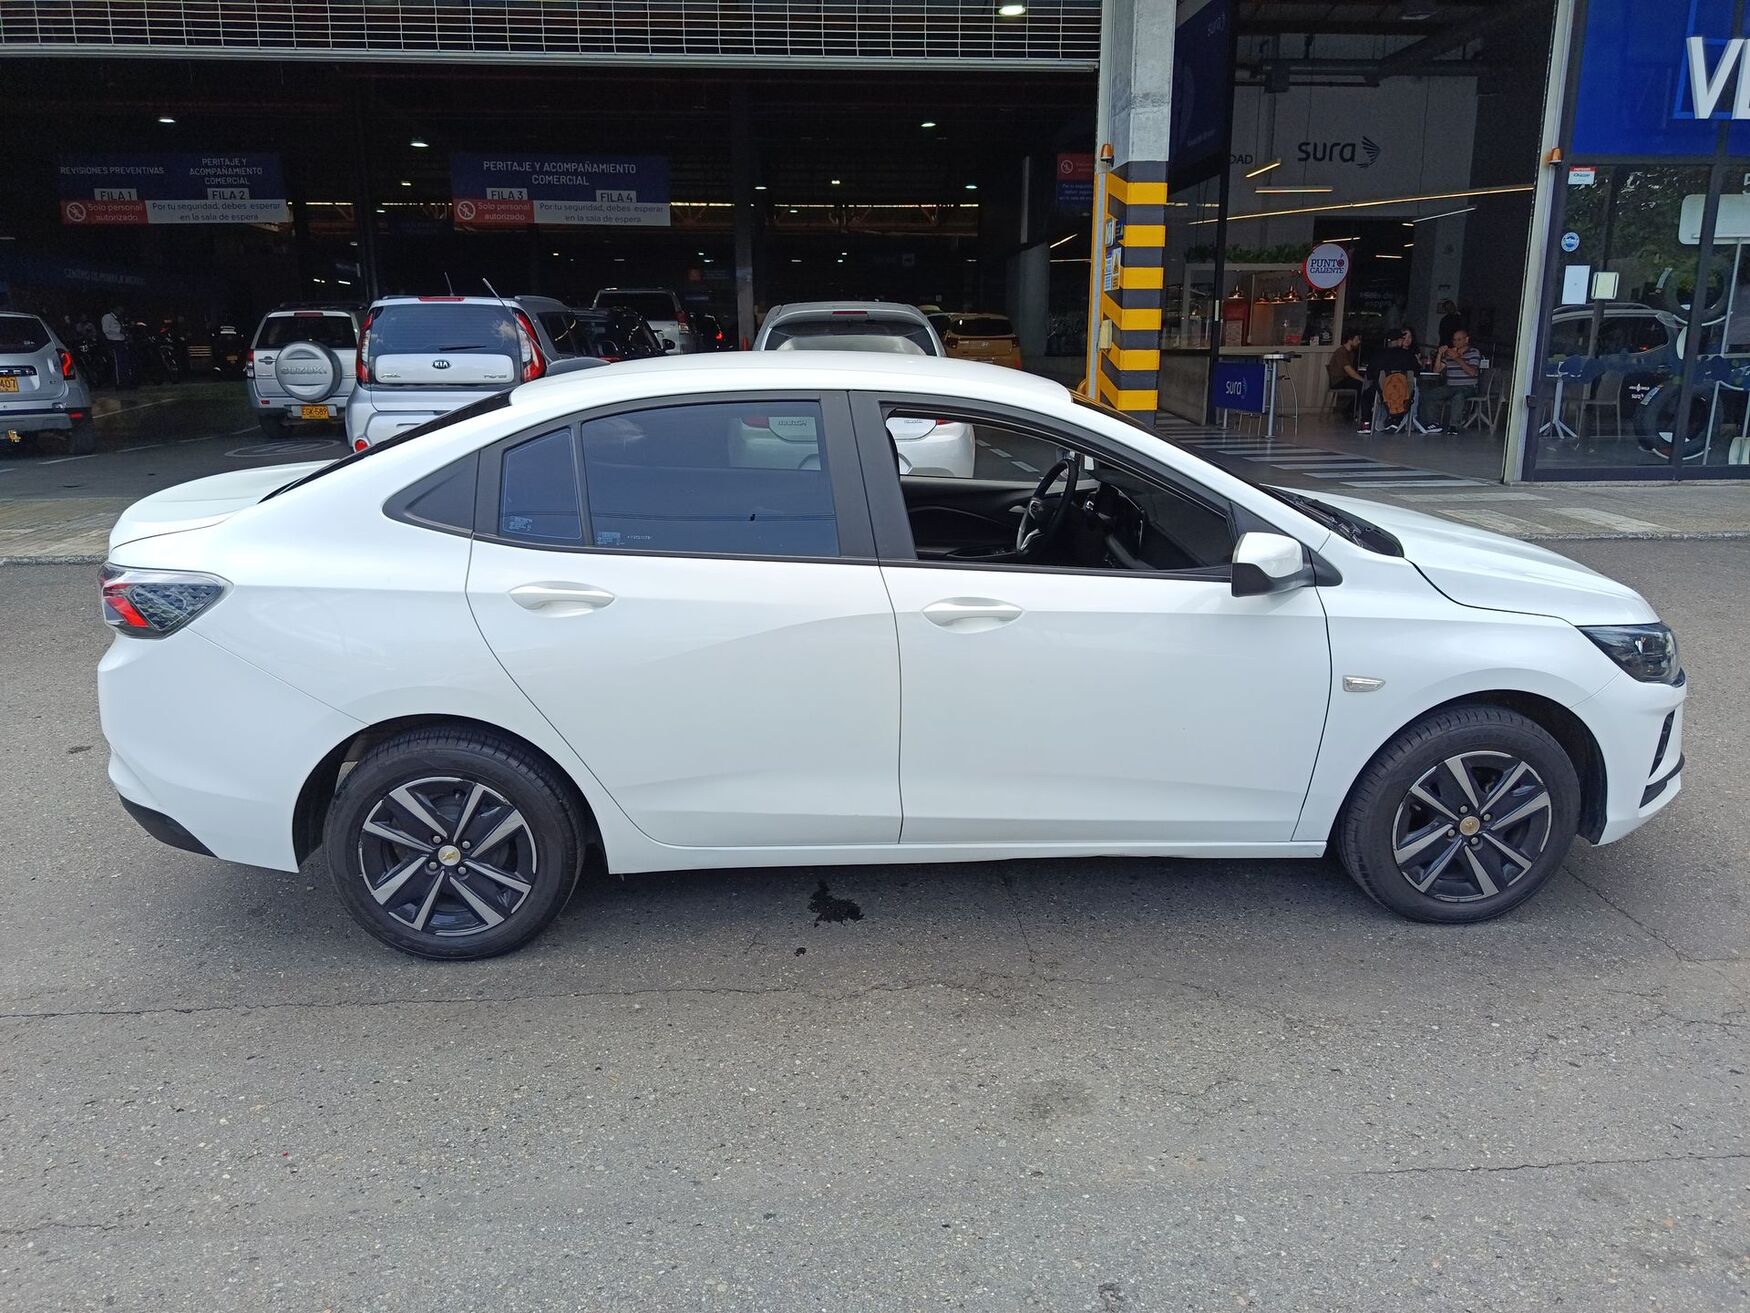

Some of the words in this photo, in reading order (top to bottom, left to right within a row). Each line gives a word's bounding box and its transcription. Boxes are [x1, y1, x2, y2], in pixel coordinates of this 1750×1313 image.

[1297, 142, 1356, 163] sura
[201, 157, 241, 166] PERITAJE
[241, 157, 247, 166] Y
[60, 166, 109, 175] REVISIONES
[109, 166, 165, 175] PREVENTIVAS
[189, 166, 263, 176] ACOMPAÑAMIENTO
[483, 160, 533, 171] PERITAJE
[534, 161, 541, 172] Y
[543, 161, 637, 174] ACOMPAÑAMIENTO
[205, 177, 250, 185] COMERCIAL
[531, 175, 590, 186] COMERCIAL
[100, 191, 126, 200] FILA
[212, 191, 236, 200] FILA
[239, 191, 245, 200] 2
[491, 191, 515, 200] FILA
[517, 191, 524, 200] 3
[600, 192, 625, 202] FILA
[626, 192, 633, 202] 4
[107, 203, 143, 213] personal
[152, 202, 166, 210] Por
[168, 202, 176, 210] tu
[221, 202, 247, 210] debes
[250, 203, 281, 212] esperar
[497, 202, 530, 212] personal
[539, 203, 553, 211] Por
[555, 203, 562, 211] tu
[606, 203, 632, 212] debes
[634, 205, 664, 214] esperar
[192, 213, 200, 221] la
[201, 213, 217, 221] sala
[219, 213, 230, 221] de
[231, 214, 259, 222] espera
[484, 213, 526, 221] autorizado
[577, 214, 585, 222] la
[585, 214, 602, 222] sala
[603, 214, 613, 222] de
[614, 216, 642, 224] espera
[280, 366, 328, 375] SUZUKI
[1225, 380, 1242, 395] sura
